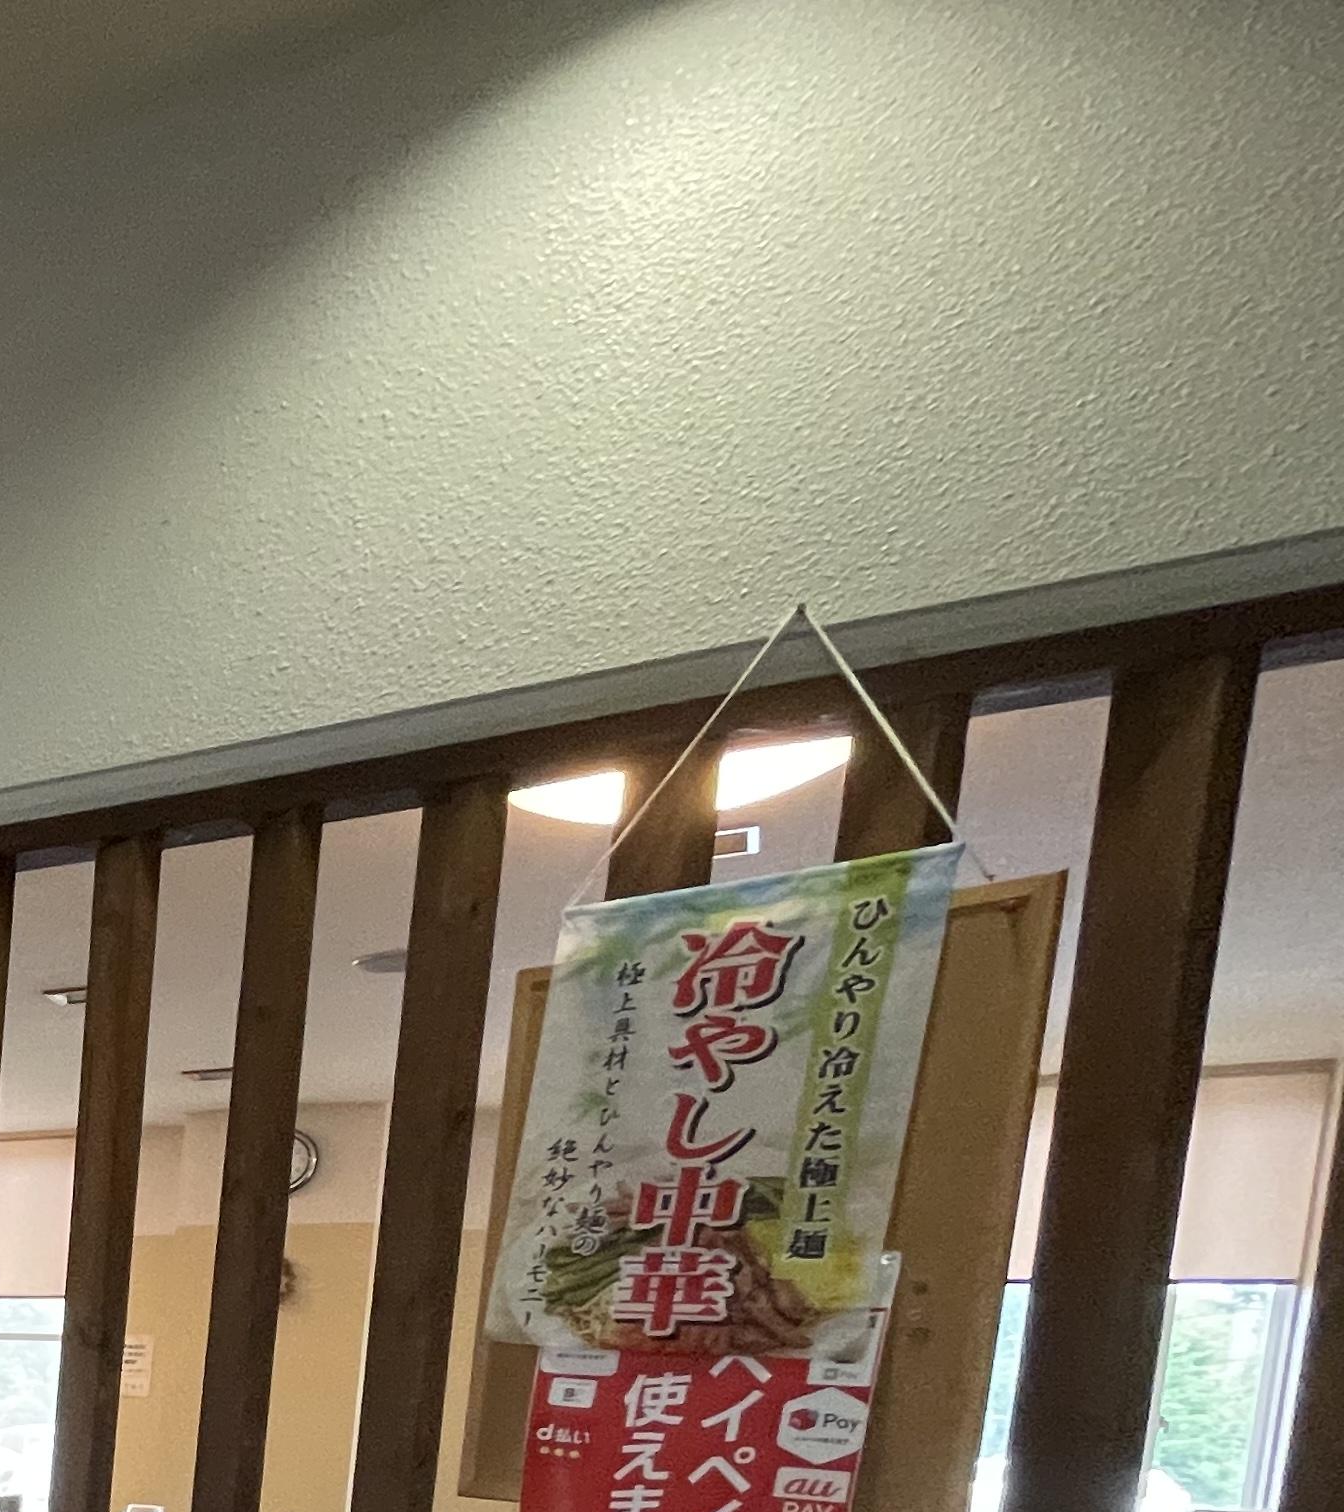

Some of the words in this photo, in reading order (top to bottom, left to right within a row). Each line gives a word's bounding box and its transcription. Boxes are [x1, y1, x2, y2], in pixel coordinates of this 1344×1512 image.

[570, 961, 647, 1257] 極上具材とひんやり麺の
[614, 921, 802, 1338] 冷やし中華
[787, 896, 889, 1261] ひんやり冷えた極上麺
[519, 1136, 579, 1327] 絶妙なハーモニー
[783, 1477, 844, 1497] au
[823, 1413, 861, 1433] Pay
